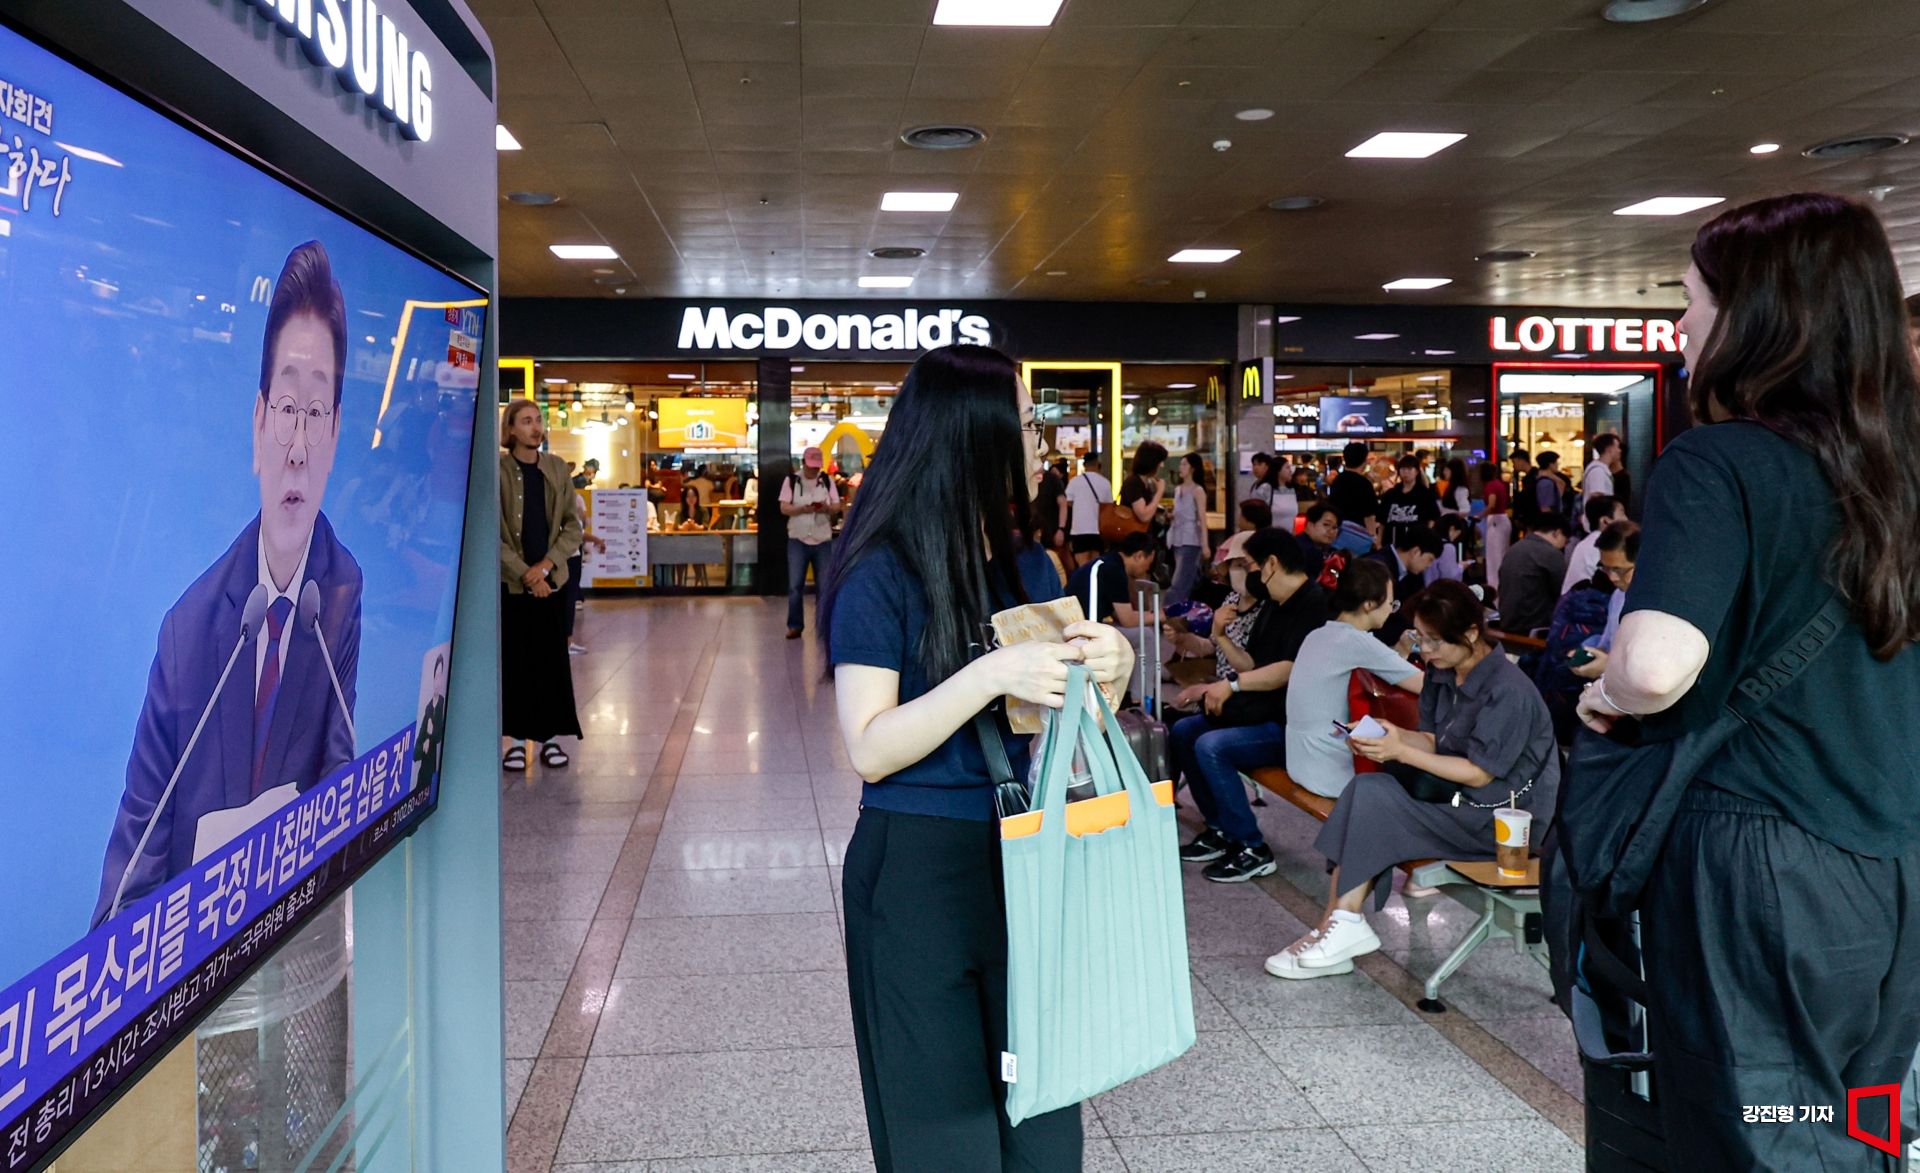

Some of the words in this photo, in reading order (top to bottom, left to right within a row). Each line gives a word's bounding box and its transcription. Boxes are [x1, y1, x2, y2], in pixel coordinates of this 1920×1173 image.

[0, 135, 72, 216] 하다
[462, 308, 480, 337] YTN
[677, 306, 992, 351] McDonald's
[45, 879, 192, 1057] 목소리를
[197, 839, 254, 941] 국정
[255, 773, 355, 896] 나침반으로
[356, 749, 389, 825] 삼을
[7, 1116, 30, 1169] 전
[34, 1077, 77, 1144] 총리
[83, 1024, 140, 1098] 13시간
[140, 973, 201, 1047] 조사받고
[286, 875, 317, 922] 줄소환
